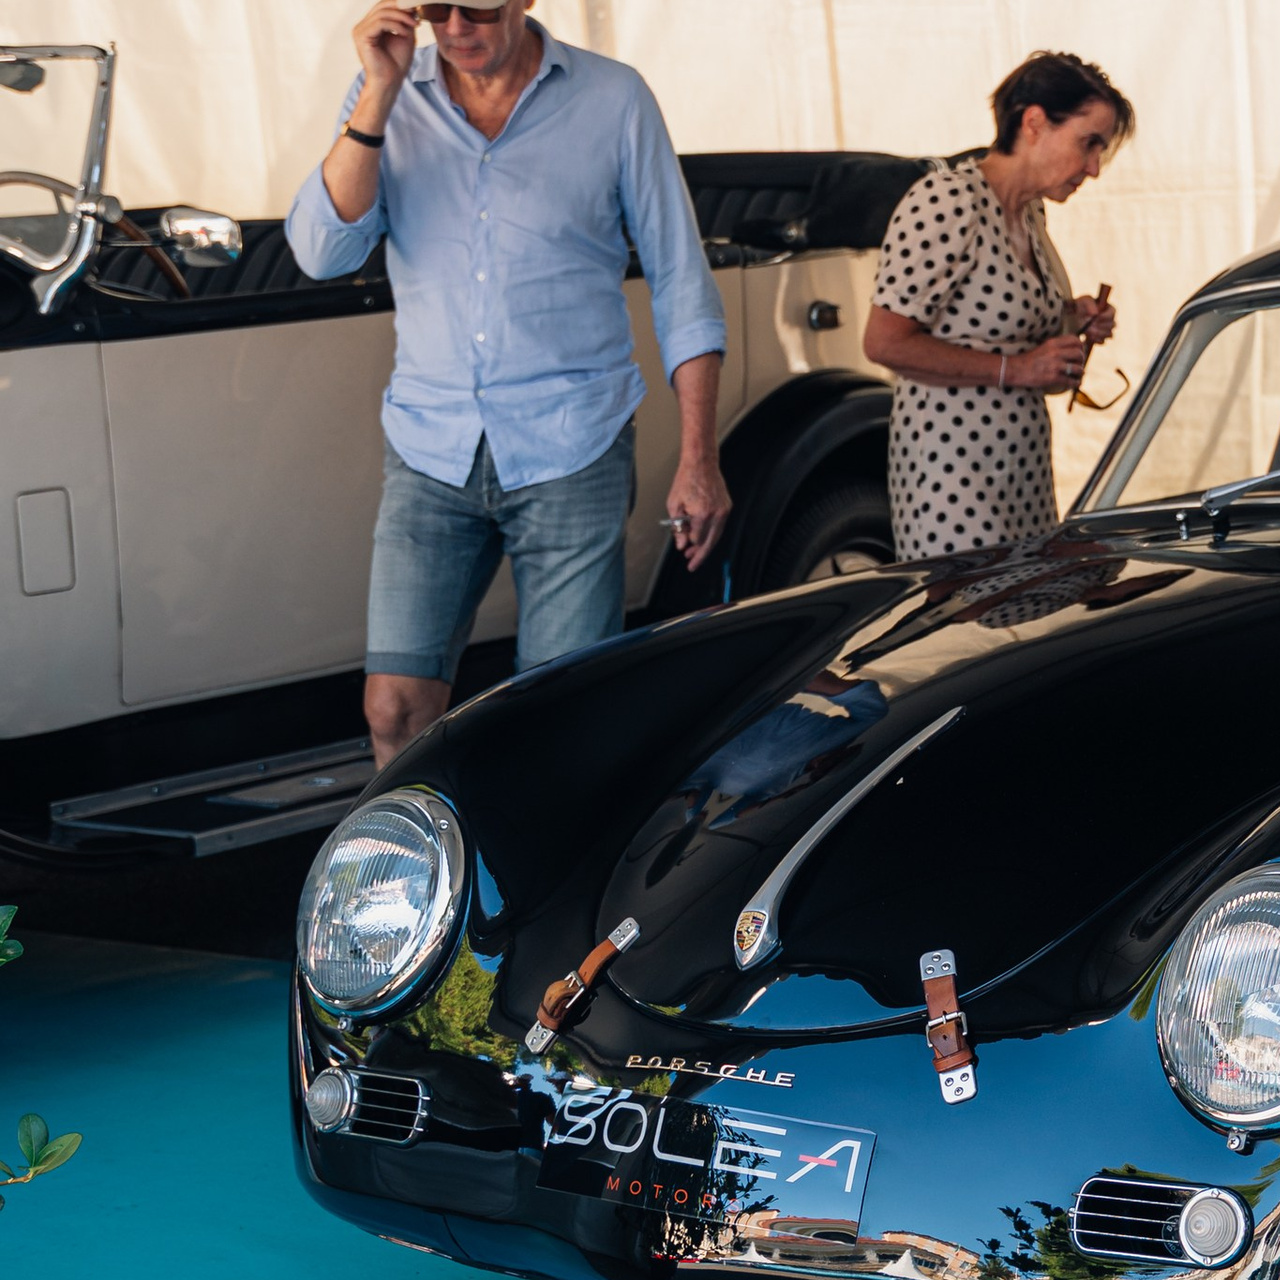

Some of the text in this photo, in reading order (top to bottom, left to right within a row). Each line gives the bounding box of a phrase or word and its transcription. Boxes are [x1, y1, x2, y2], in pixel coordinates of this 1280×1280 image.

[626, 1055, 796, 1088] PORSCHE
[554, 1094, 861, 1193] SOLEA
[606, 1176, 739, 1214] MOTORS
